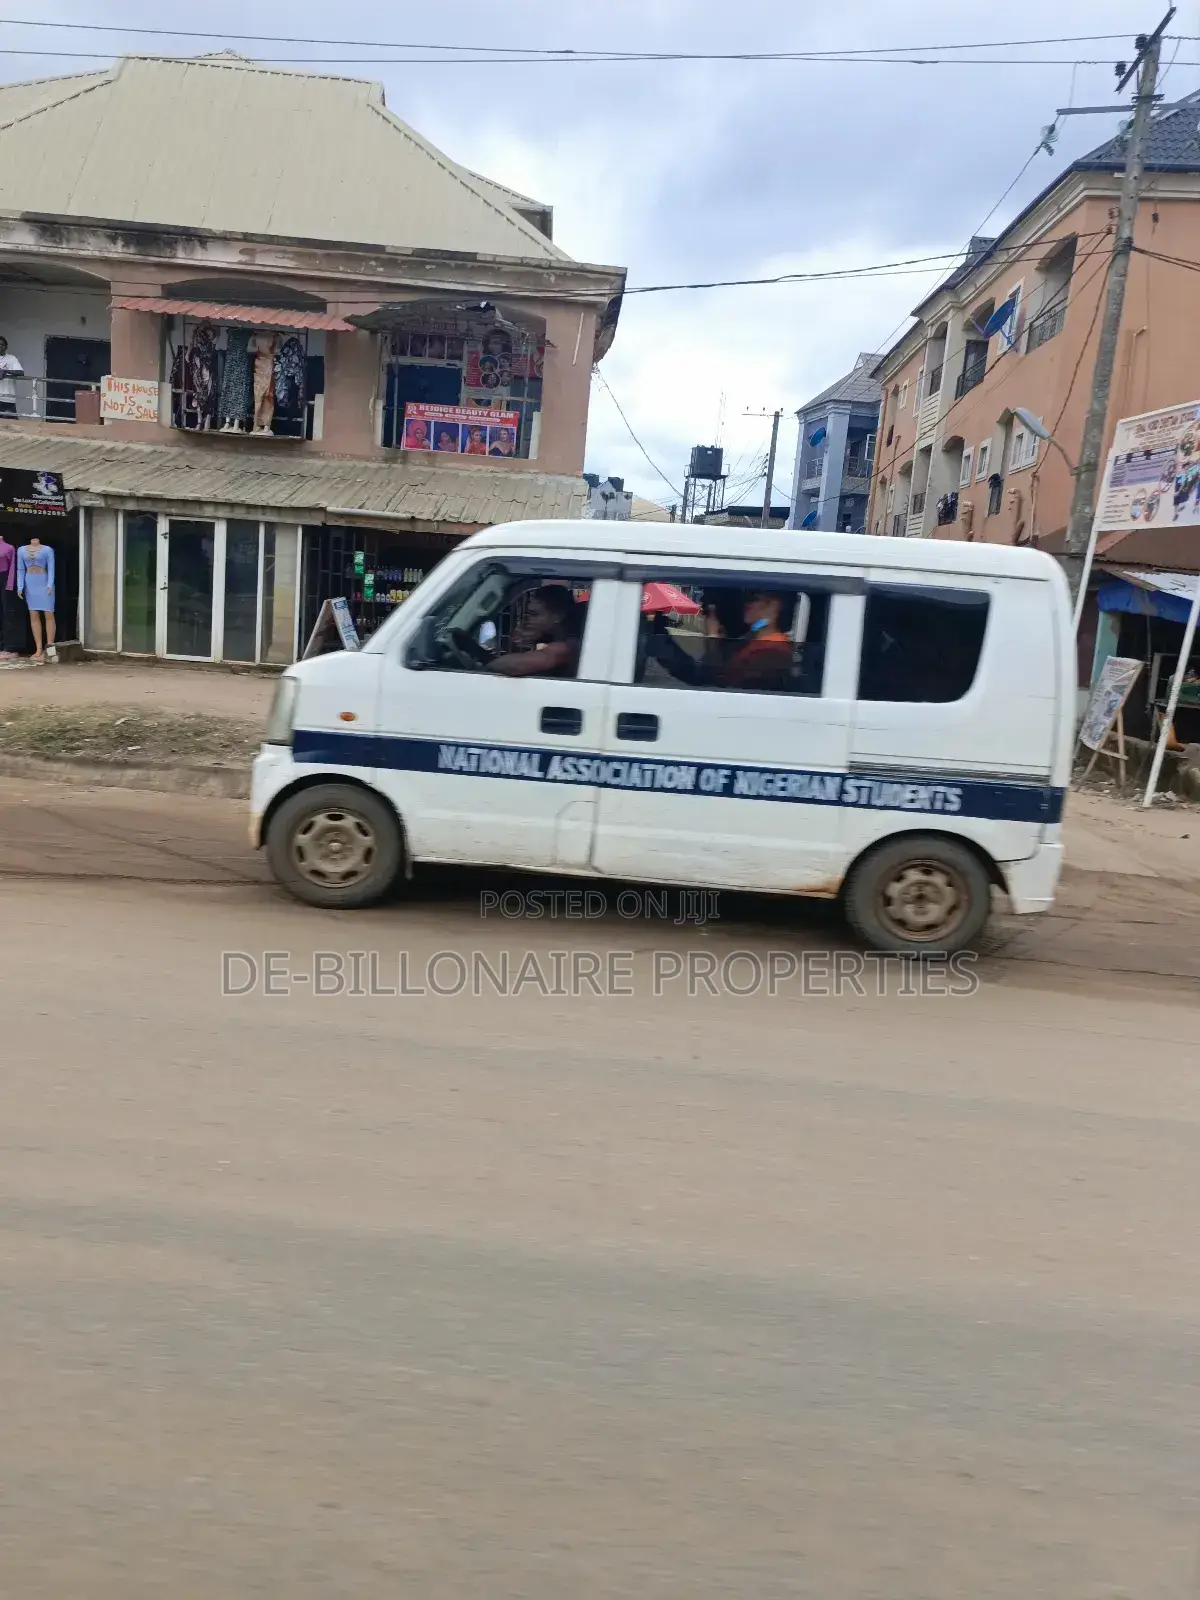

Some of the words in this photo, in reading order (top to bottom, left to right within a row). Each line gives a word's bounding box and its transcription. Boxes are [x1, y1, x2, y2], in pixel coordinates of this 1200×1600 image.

[107, 378, 130, 393] THIS
[132, 384, 159, 396] HOUSE
[103, 399, 125, 414] NOT
[135, 405, 159, 419] SALE
[124, 395, 136, 407] IS
[419, 404, 454, 414] REJOICE
[455, 408, 489, 417] BEAUTY
[490, 411, 514, 419] GLAM
[437, 744, 544, 778] NATIONAL
[546, 755, 699, 790] ASSOCIATION
[700, 767, 732, 793] OF
[733, 770, 842, 800] NIGERIAN
[842, 778, 963, 812] STUDENTS
